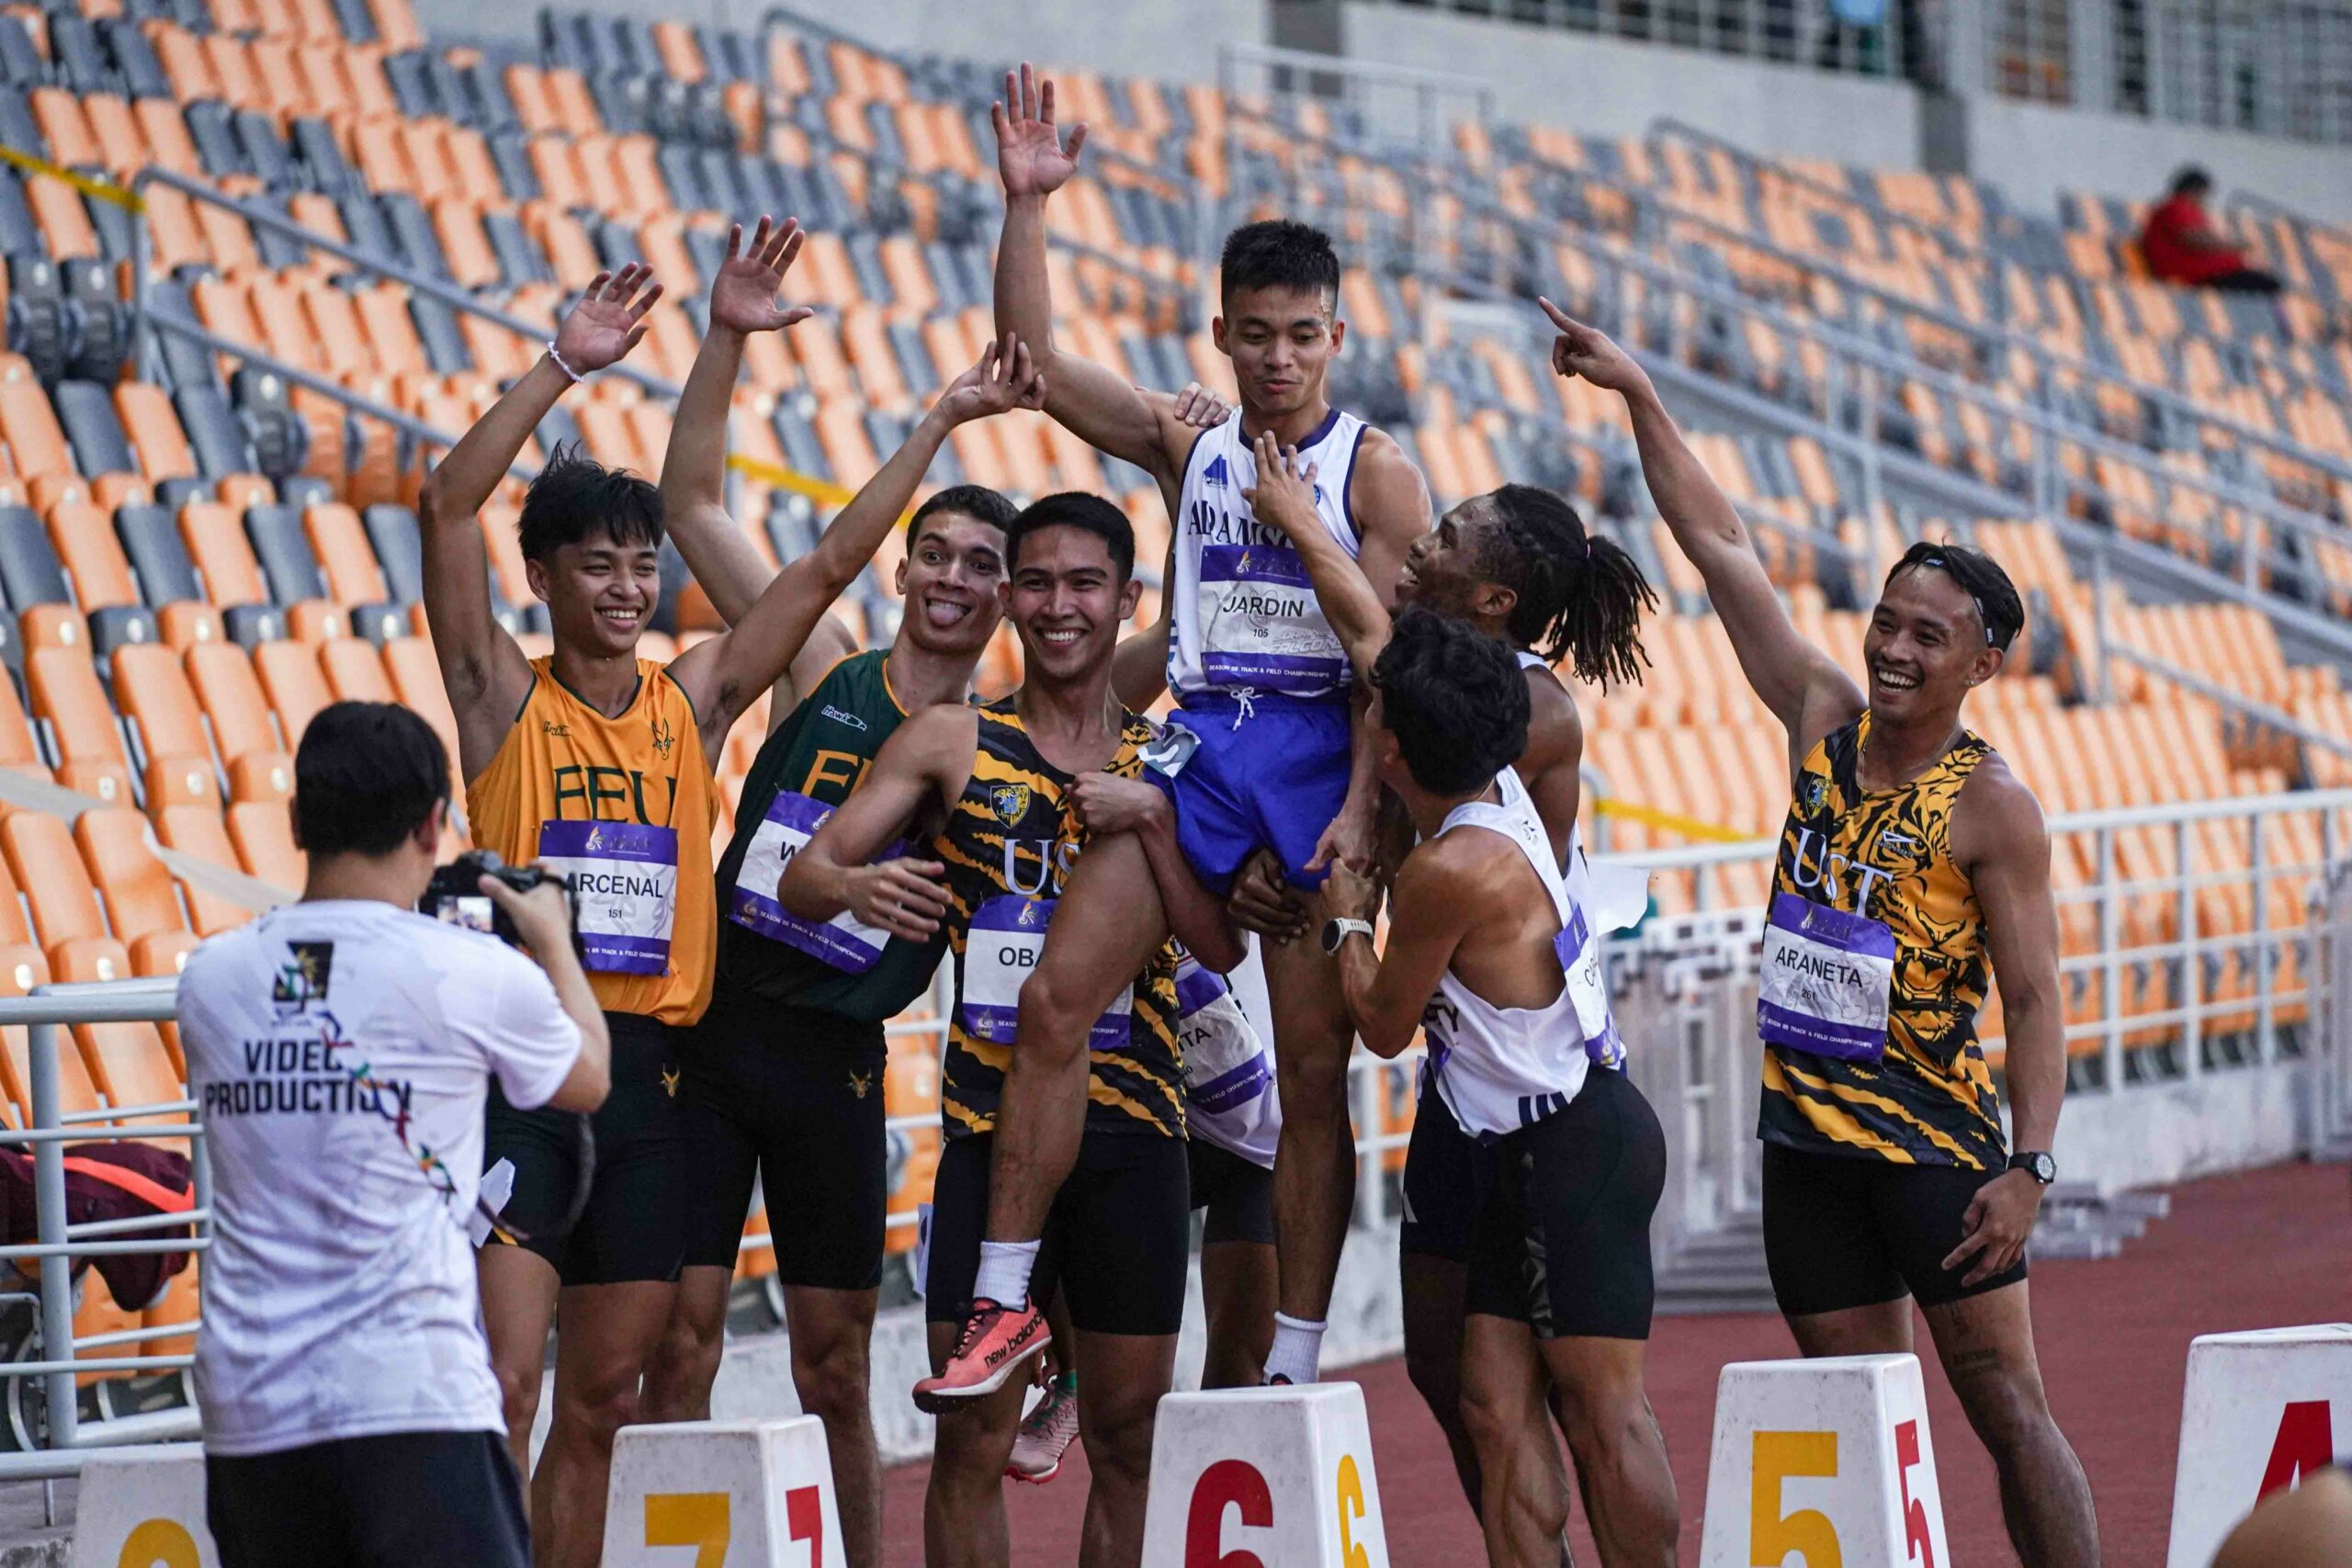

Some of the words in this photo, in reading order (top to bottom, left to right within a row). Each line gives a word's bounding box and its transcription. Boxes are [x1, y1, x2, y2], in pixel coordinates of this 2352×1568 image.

[1223, 596, 1305, 617] JARDIN
[1253, 628, 1269, 637] 105
[554, 764, 677, 828] FEU
[567, 872, 664, 898] ARCENAL
[1792, 827, 1894, 917] UST
[607, 908, 623, 919] 151
[601, 948, 617, 956] TRACK
[625, 950, 639, 958] FIELD
[1775, 945, 1863, 988] ARANETA
[1802, 988, 1815, 1000] 261
[1814, 1032, 1828, 1042] FIELD
[205, 1079, 411, 1117] PRODUCTION
[984, 1346, 1007, 1369] new
[1749, 1431, 1842, 1568] 5
[1894, 1419, 1935, 1568] 5
[1184, 1459, 1273, 1568] 6
